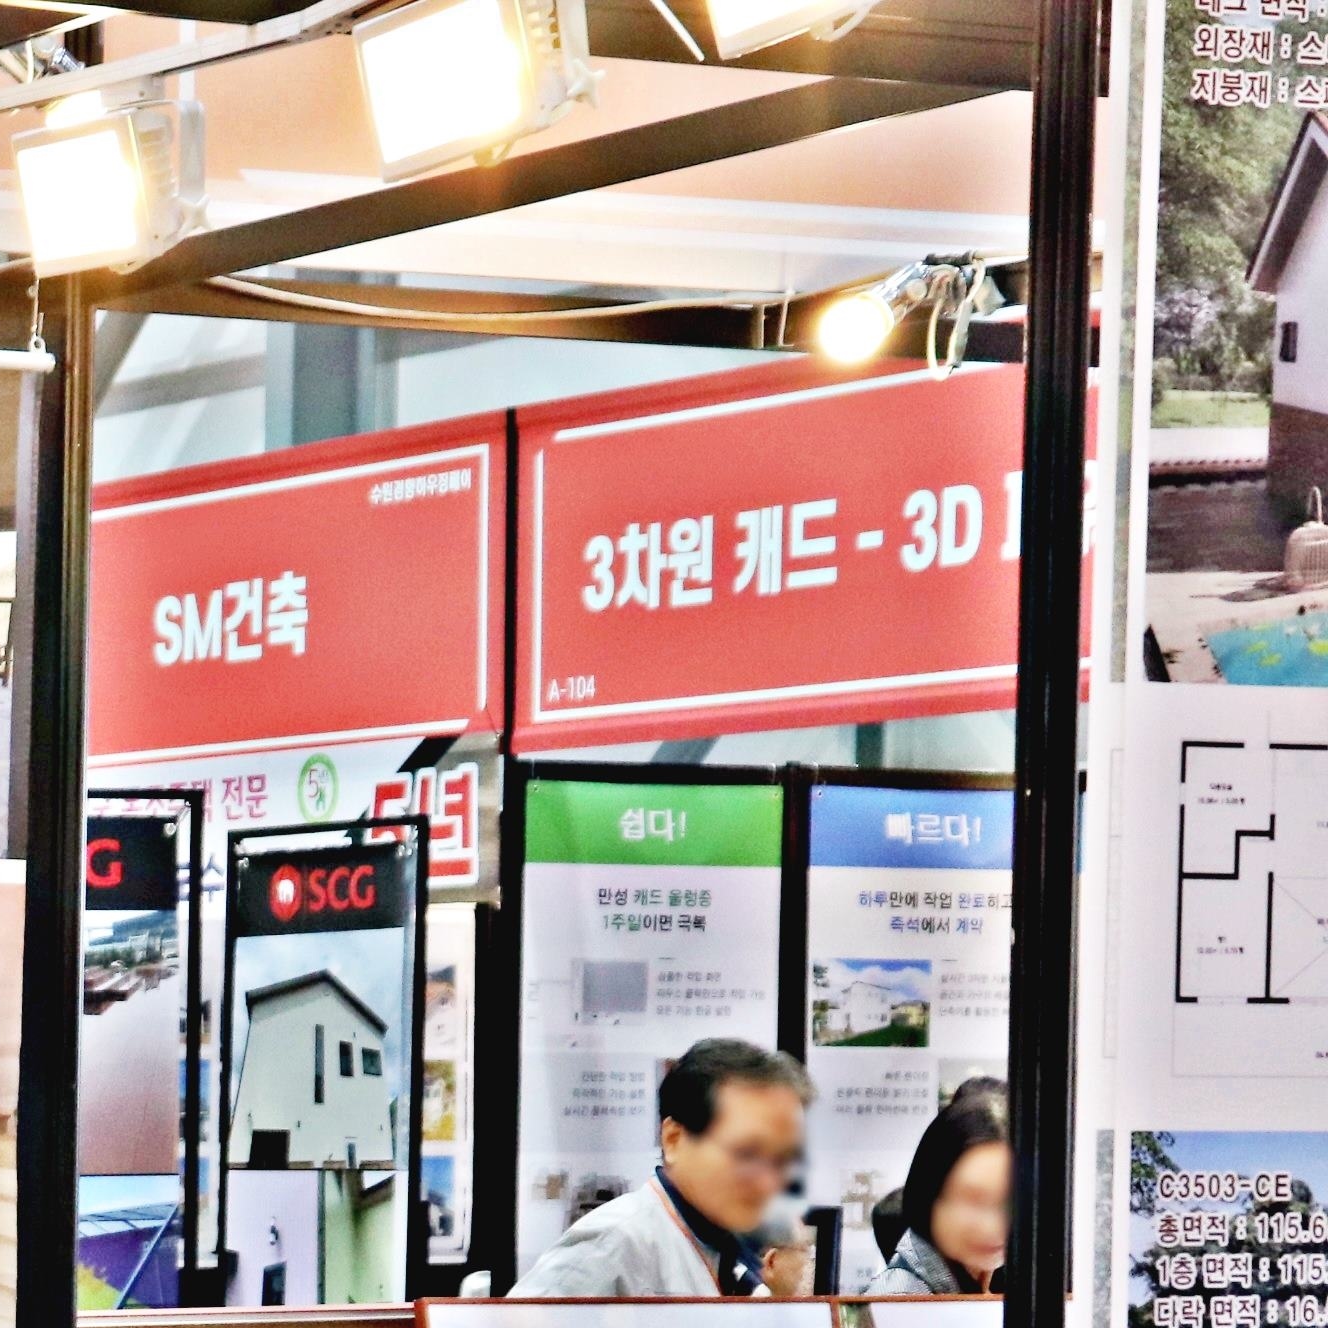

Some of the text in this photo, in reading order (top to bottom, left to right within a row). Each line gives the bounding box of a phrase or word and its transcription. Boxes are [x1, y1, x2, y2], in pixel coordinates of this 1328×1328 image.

[1195, 26, 1273, 61] 외장재
[1299, 33, 1328, 62] 스
[1193, 70, 1271, 104] 지붕재
[582, 513, 715, 614] 3차원
[732, 497, 838, 596] 캐드
[900, 483, 984, 573] 3D
[152, 569, 309, 667] SM건축
[547, 674, 597, 702] A-104
[220, 773, 269, 820] 전문
[619, 806, 687, 843] 쉽다!
[884, 811, 982, 846] 빠르다!
[307, 864, 377, 914] SCG
[598, 888, 628, 906] 만성
[633, 888, 664, 906] 캐드
[859, 890, 919, 909] 하루만에
[923, 891, 953, 909] 작업
[604, 913, 707, 932] 1주일이면 극복
[890, 916, 984, 933] 즉석에서 계약
[1158, 1172, 1290, 1199] C3503-CE
[1158, 1213, 1226, 1245] 총면적
[1157, 1257, 1194, 1286] 1층
[1205, 1257, 1250, 1287] 면적
[1157, 1297, 1202, 1328] 다락
[1213, 1298, 1257, 1328] 면적
